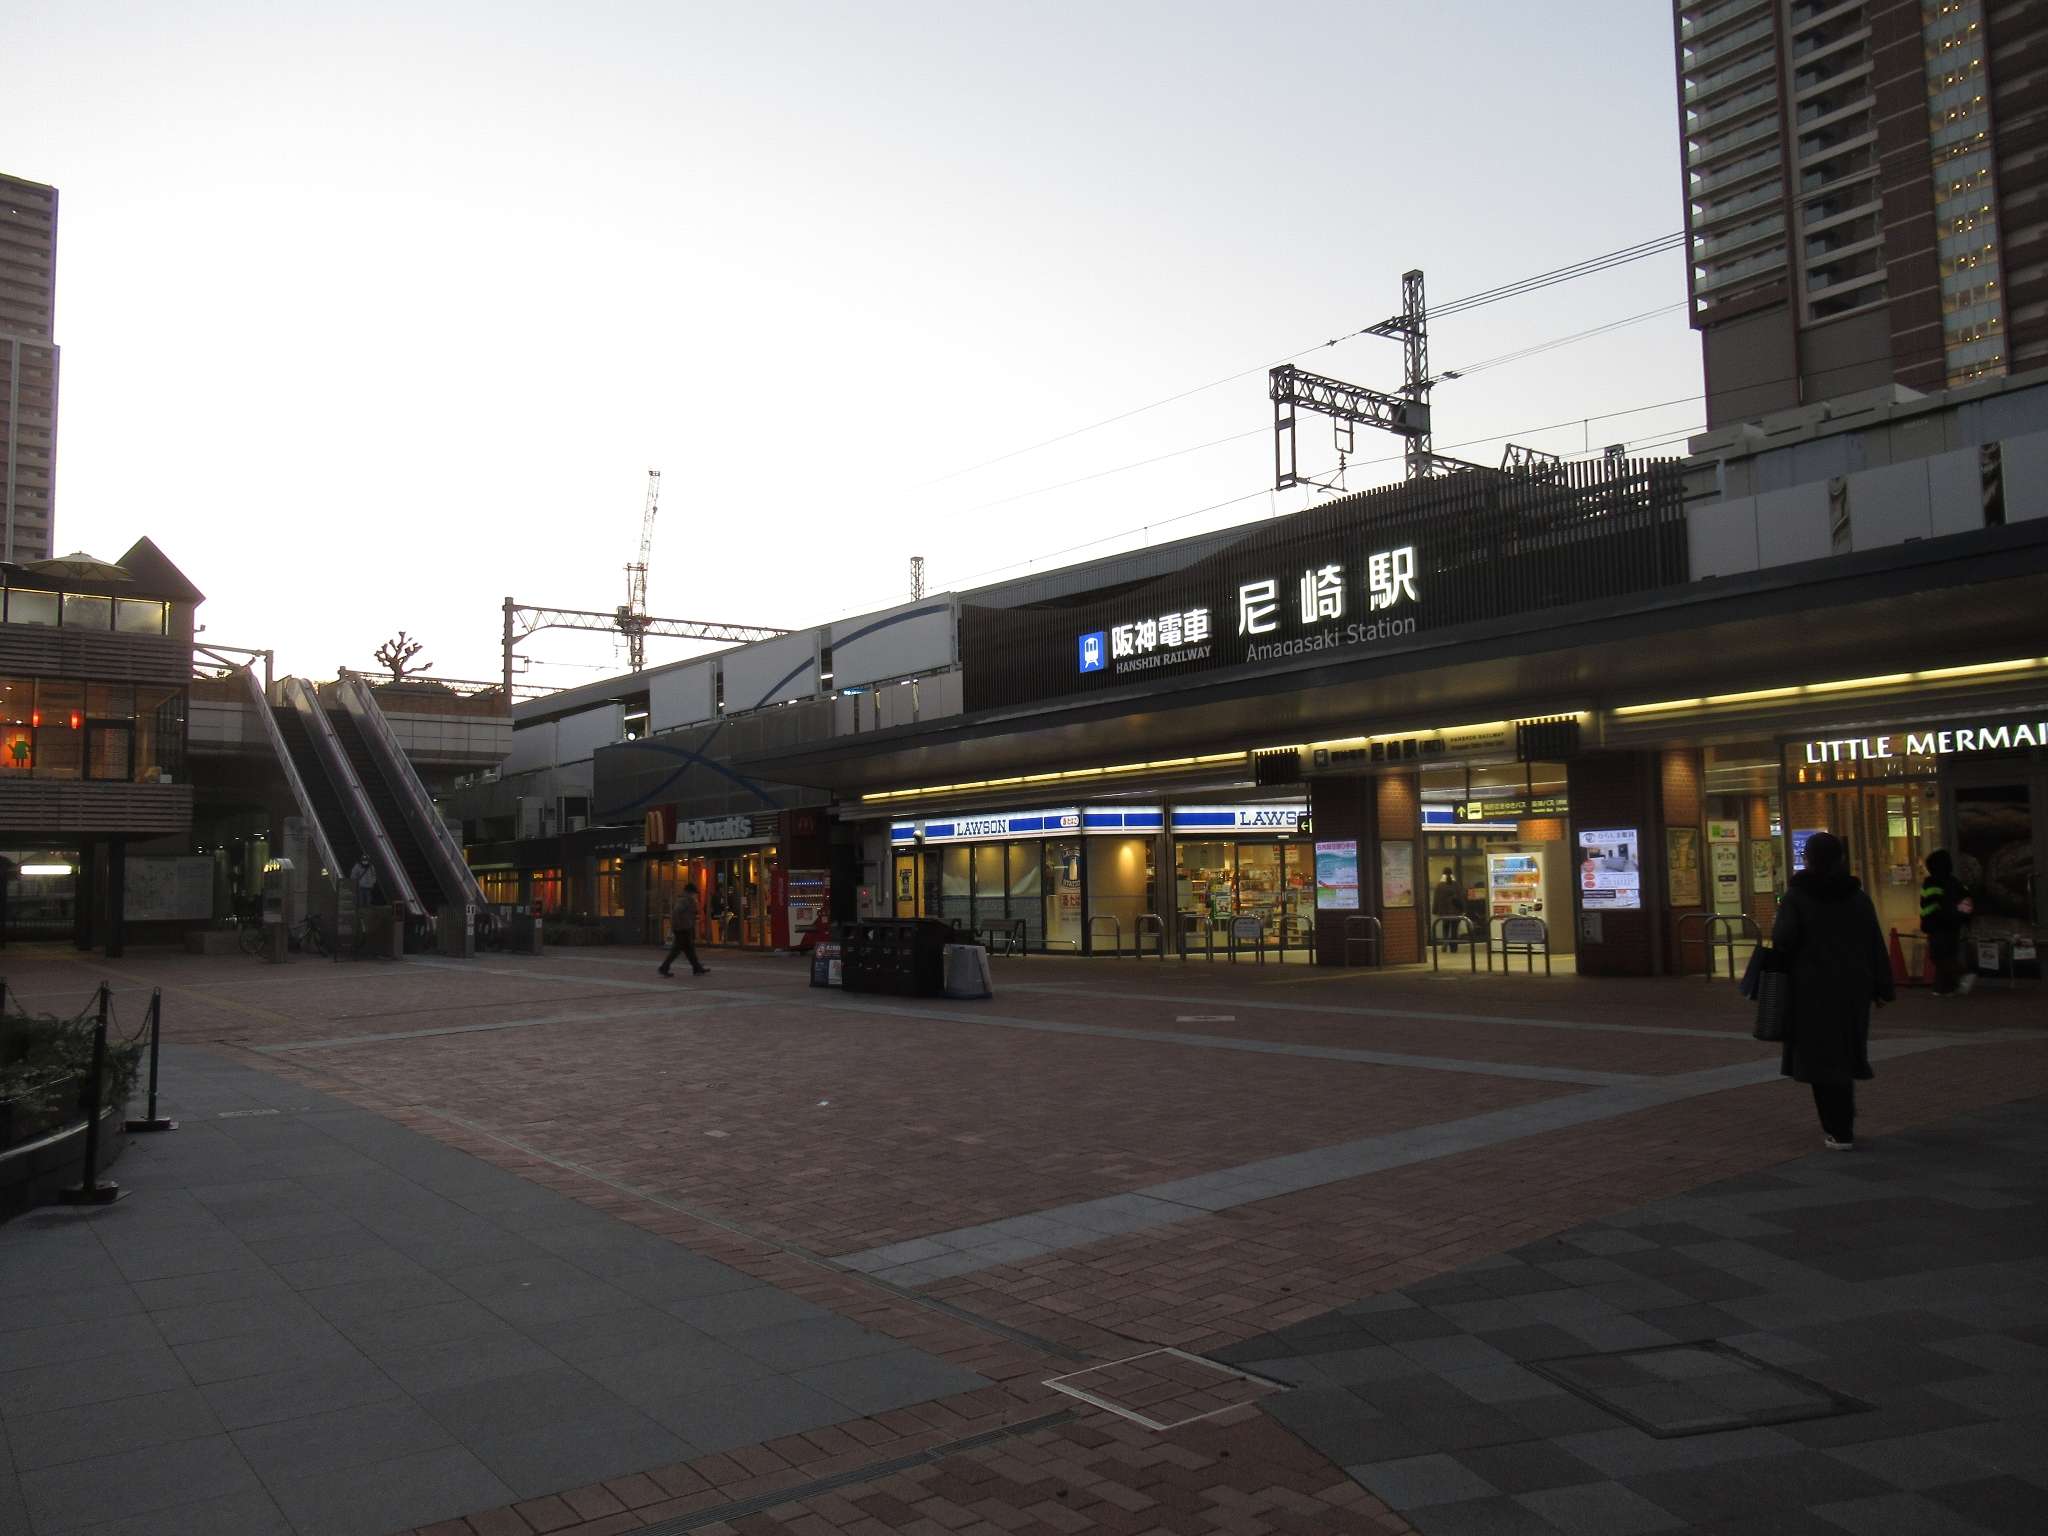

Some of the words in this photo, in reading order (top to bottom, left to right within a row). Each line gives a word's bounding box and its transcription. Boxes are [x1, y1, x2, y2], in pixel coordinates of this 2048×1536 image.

[1238, 546, 1417, 638] 尼崎駅
[1111, 608, 1209, 660] 阪神電車
[1246, 627, 1339, 663] Amagasaki
[1346, 617, 1416, 645] Station
[1116, 656, 1161, 675] HANSHIN
[1163, 645, 1212, 666] RAILWAY
[1805, 736, 1893, 764] LITTLE
[1906, 722, 2048, 757] MERMAI
[956, 819, 1007, 837] LAWSON
[1239, 811, 1310, 826] LAWS
